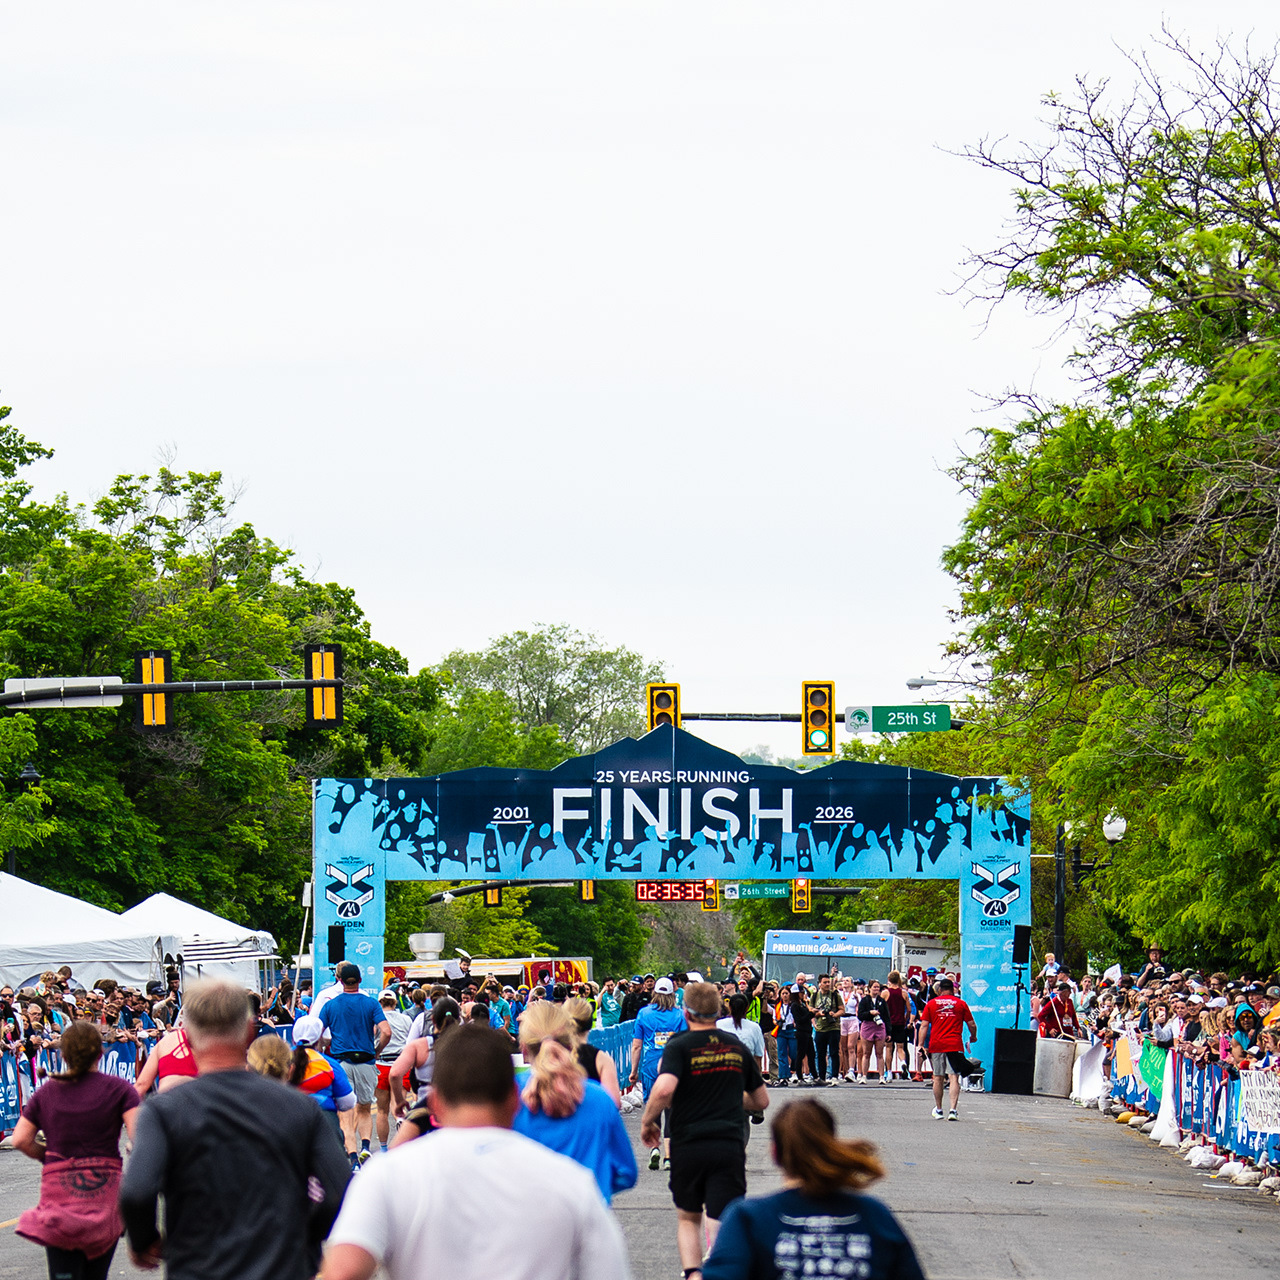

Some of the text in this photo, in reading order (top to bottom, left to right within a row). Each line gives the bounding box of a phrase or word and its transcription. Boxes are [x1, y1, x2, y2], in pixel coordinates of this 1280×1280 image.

[888, 712, 936, 725] 25th St
[596, 771, 749, 783] 25 YEARS RUNNING
[493, 807, 529, 819] 2001
[552, 788, 793, 840] FINISH
[815, 806, 853, 819] 2026
[637, 884, 705, 899] 02:35:35
[741, 886, 786, 895] 26th Street
[772, 943, 819, 953] PROMOTING
[853, 947, 885, 955] ENERGY
